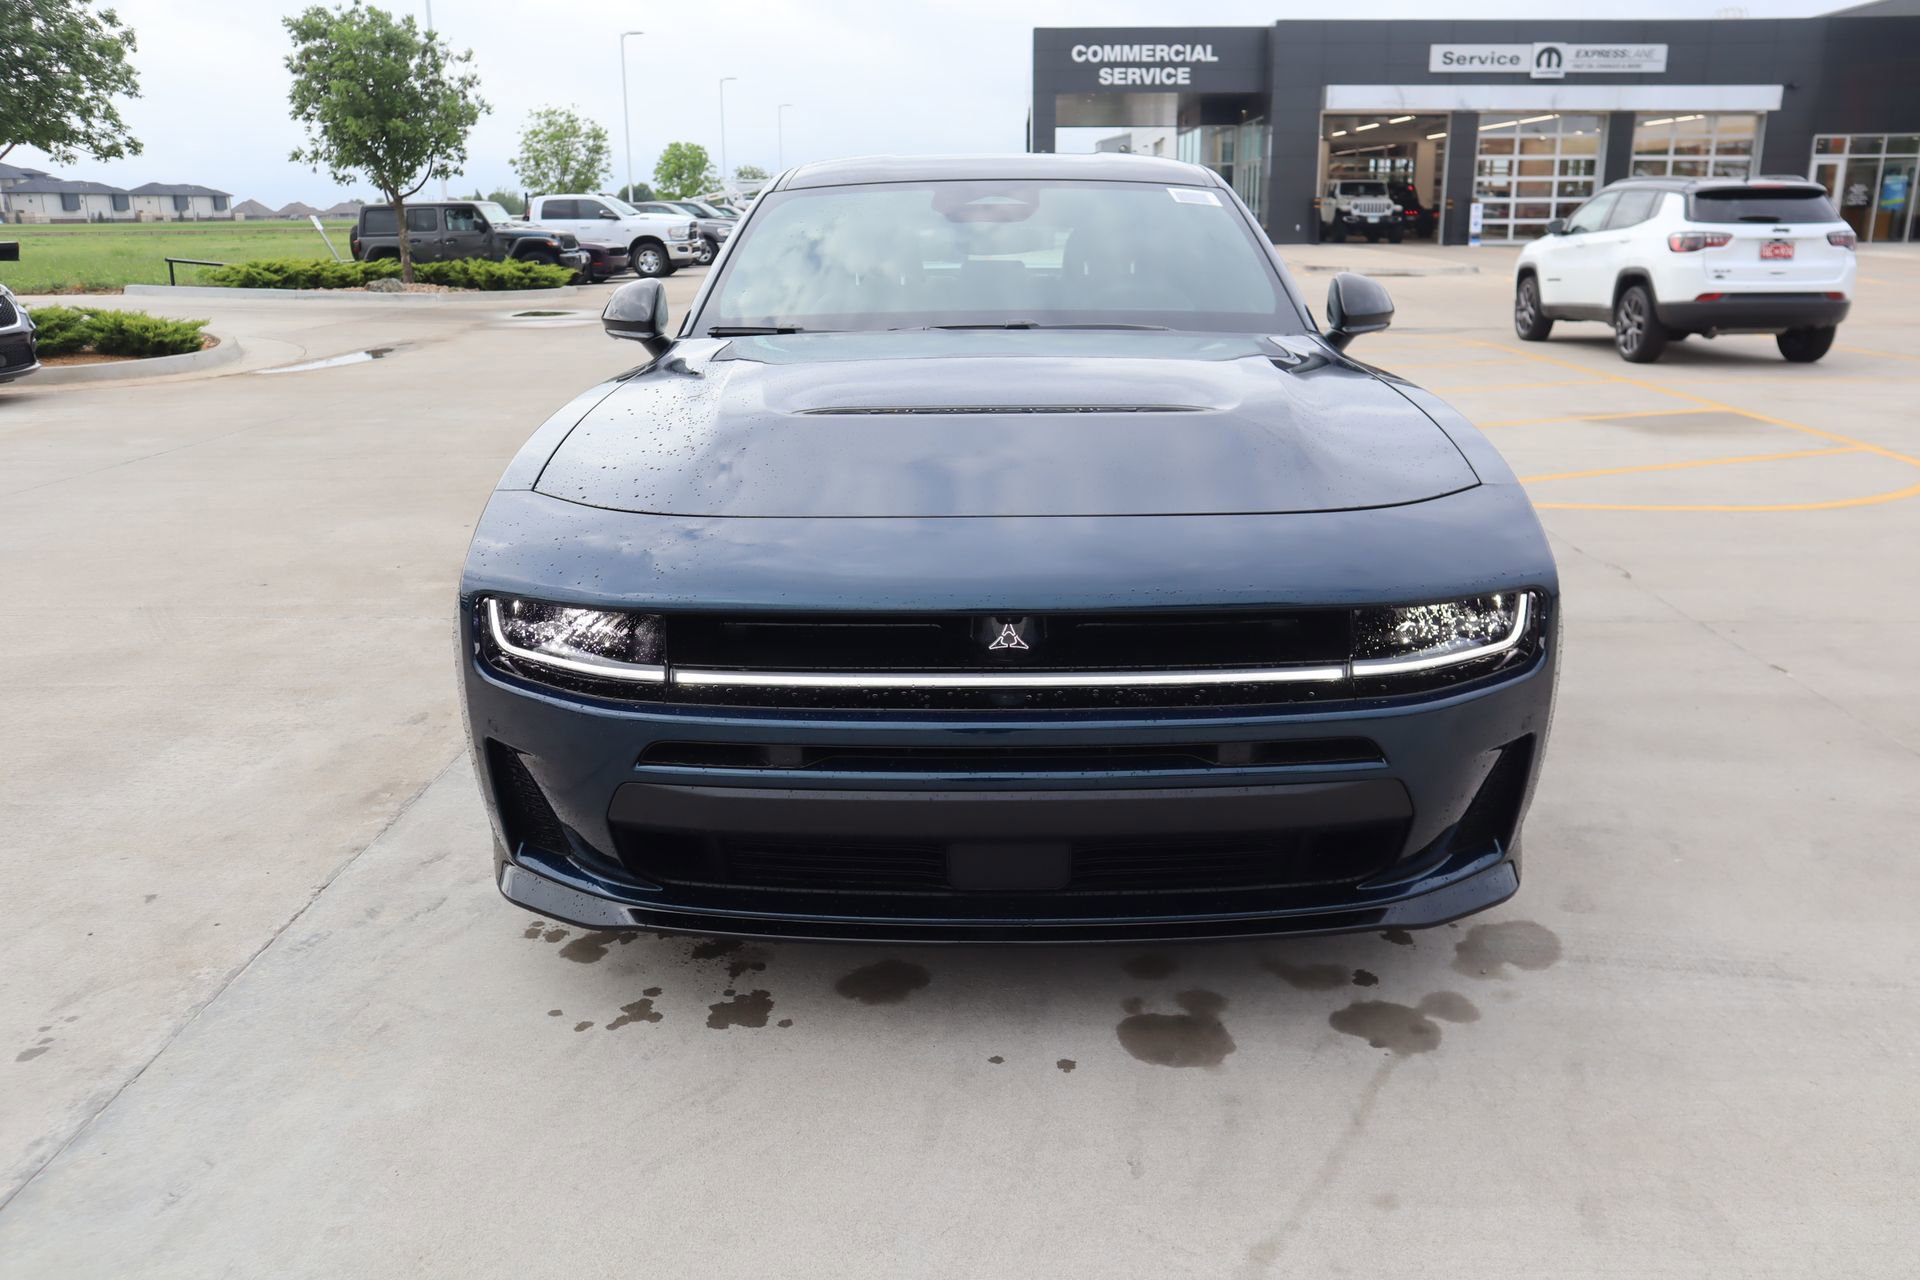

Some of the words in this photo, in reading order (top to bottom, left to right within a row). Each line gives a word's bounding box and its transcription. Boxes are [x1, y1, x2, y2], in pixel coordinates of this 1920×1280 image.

[1071, 44, 1219, 63] COMMERCIAL
[1442, 50, 1521, 66] Service
[1098, 67, 1191, 86] SERVICE
